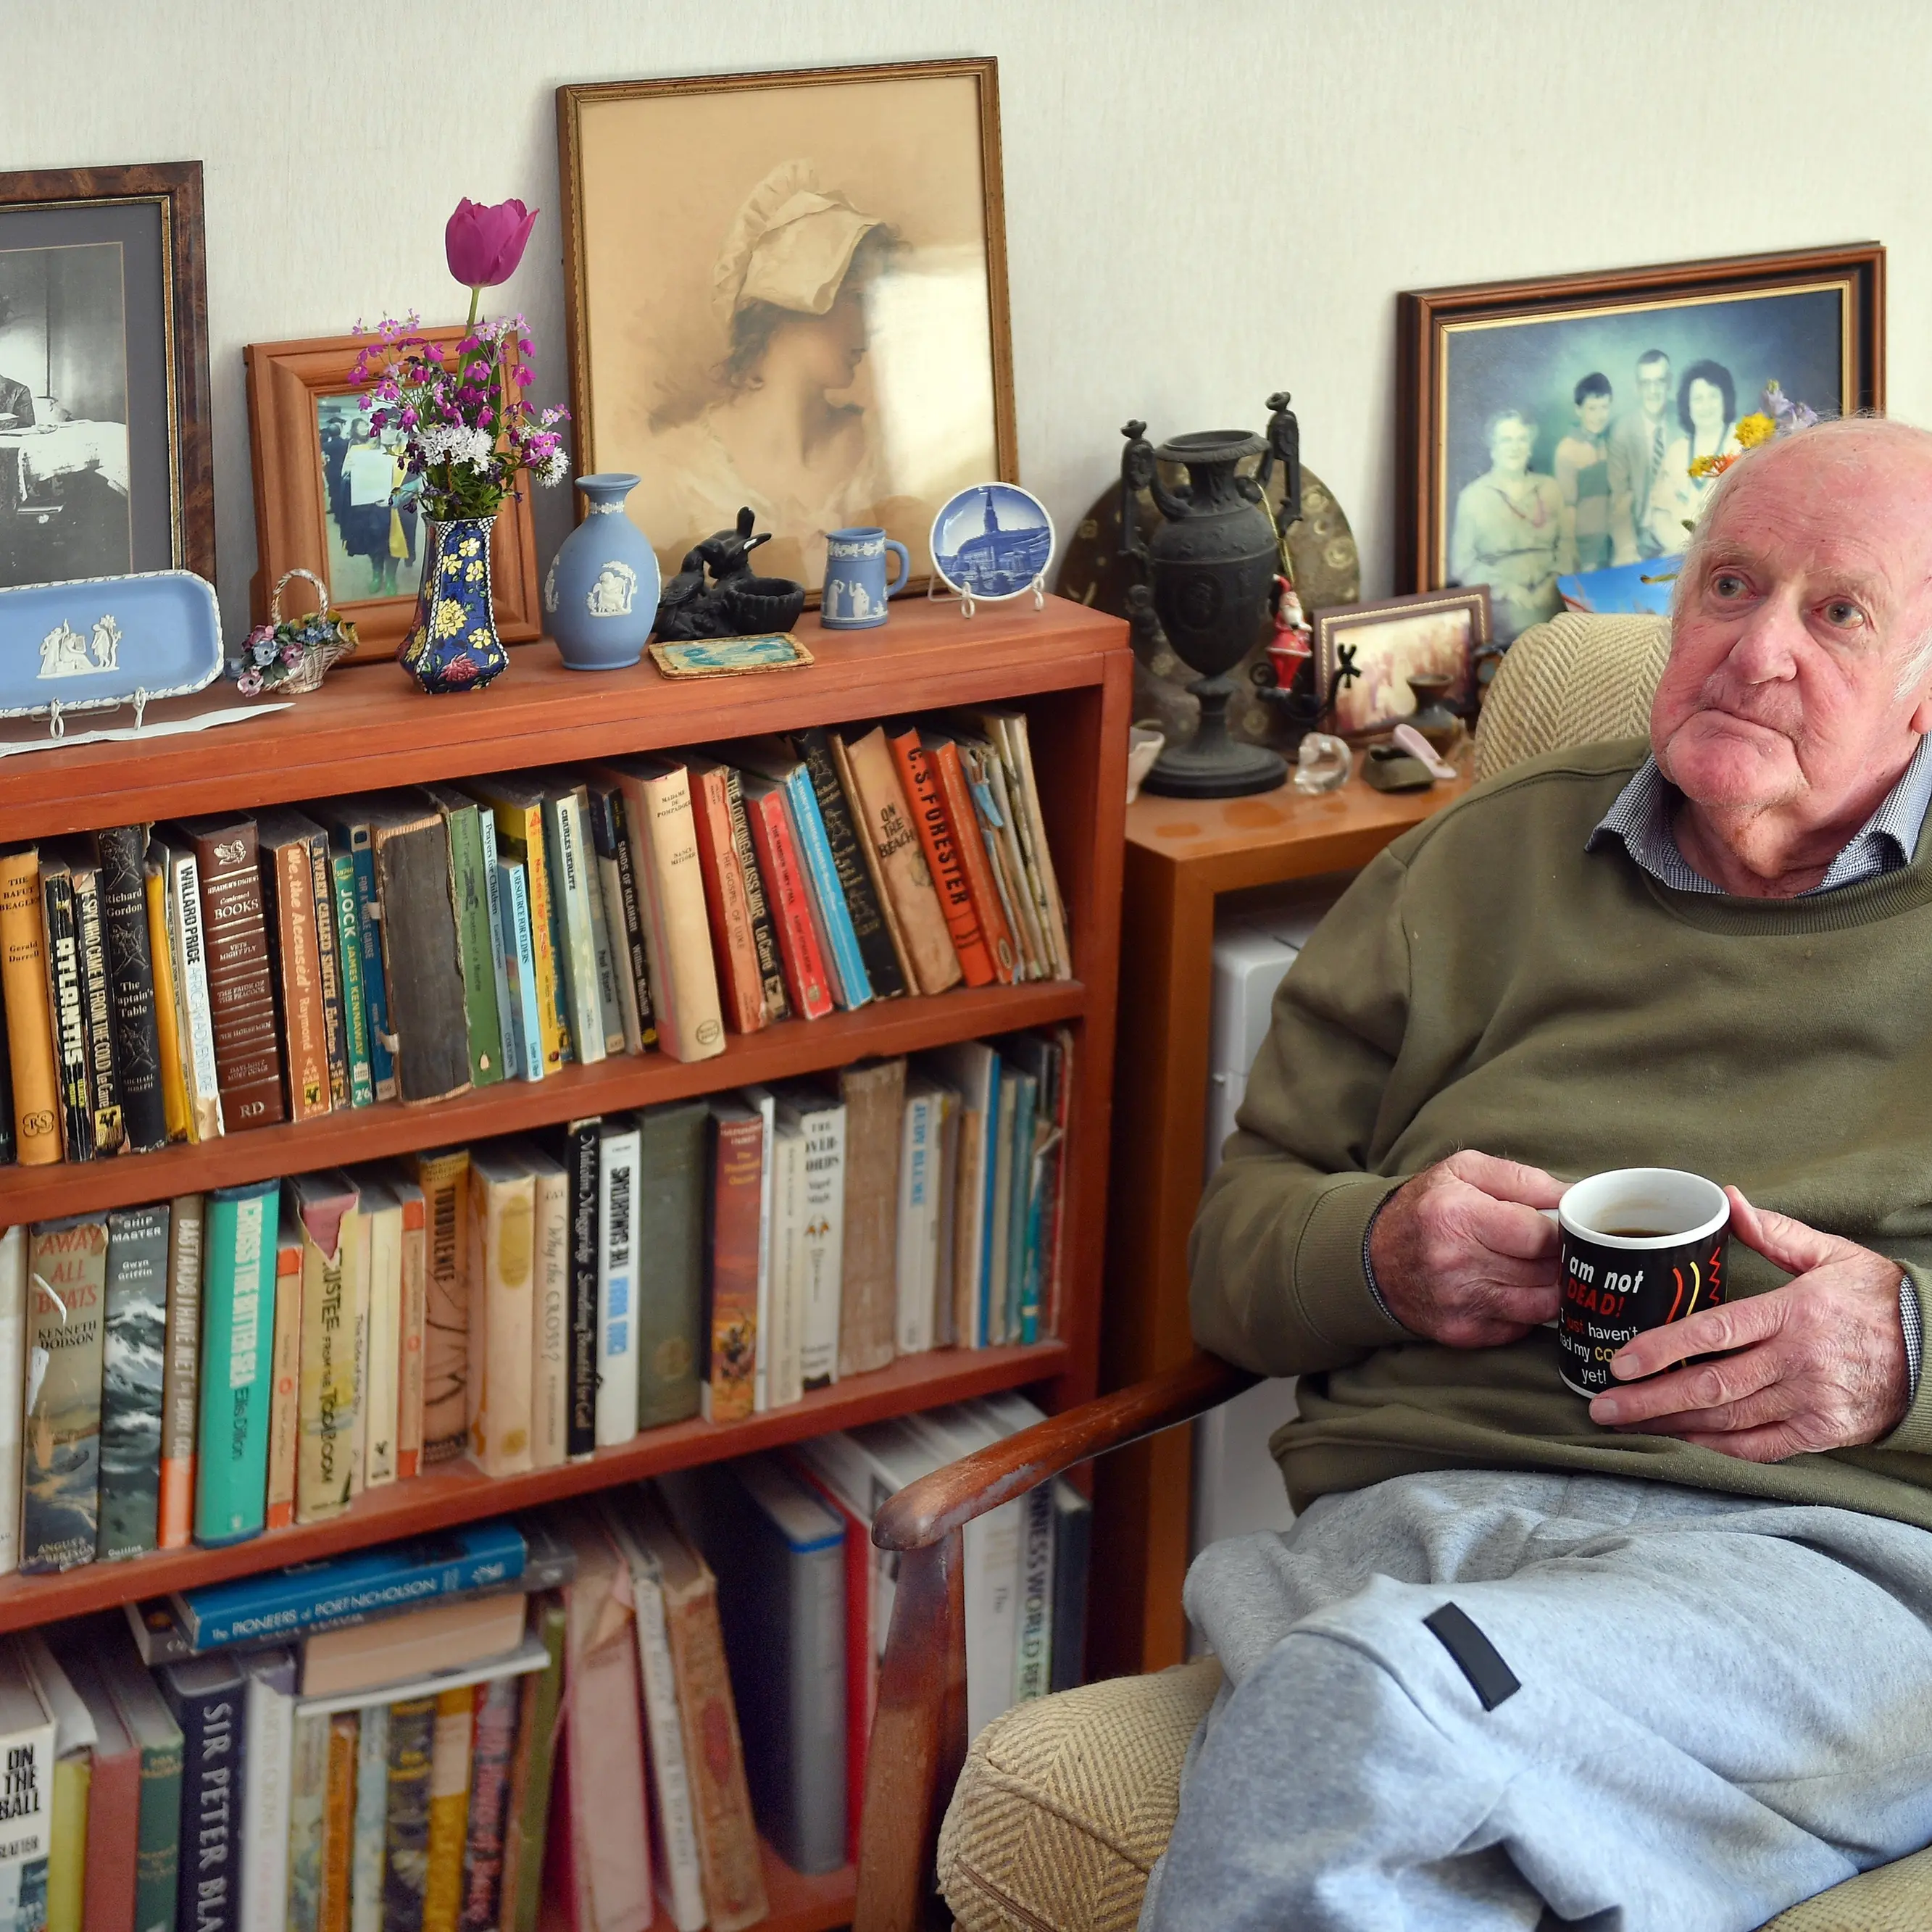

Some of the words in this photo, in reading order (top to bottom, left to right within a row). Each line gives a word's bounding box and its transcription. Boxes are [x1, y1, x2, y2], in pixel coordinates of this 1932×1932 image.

[662, 789, 685, 803] MADAME
[880, 802, 896, 822] ON
[484, 823, 496, 858] Prayers
[560, 809, 573, 851] CHARLES
[878, 828, 915, 857] BEACH
[880, 817, 904, 838] THE
[313, 846, 324, 857] A
[617, 841, 630, 871] SANDS
[673, 847, 692, 858] NANCY
[722, 851, 733, 869] THE
[725, 778, 741, 801] THE
[748, 891, 766, 919] WAR
[8, 875, 29, 886] THE
[315, 857, 328, 899] WREN
[488, 858, 498, 873] for
[565, 851, 577, 891] BERLITZ
[622, 873, 631, 885] OF
[3, 886, 36, 899] BAFUT
[106, 887, 143, 904] Richard
[180, 865, 198, 928] WILLARD
[489, 874, 500, 915] Children
[513, 877, 525, 917] RESOURCE
[725, 872, 738, 907] GOSPEL
[82, 899, 100, 920] SPY
[107, 902, 143, 917] Gordon
[214, 899, 259, 920] BOOKS
[340, 888, 357, 939] JOCK
[358, 875, 369, 892] FOR
[364, 933, 375, 959] CAUSE
[623, 887, 638, 933] KALAHARI
[732, 909, 742, 923] OF
[83, 919, 101, 946] WHO
[318, 902, 333, 952] CALLED
[518, 918, 527, 934] FOR
[734, 926, 746, 950] LUKE
[9, 941, 38, 953] Gerald
[9, 951, 40, 963] Durrell
[86, 946, 104, 977] CAME
[185, 927, 201, 966] PRICE
[292, 912, 311, 986] Accused
[520, 935, 530, 964] ELDERS
[598, 950, 610, 968] Paul
[631, 944, 645, 977] William
[320, 954, 337, 999] SMITH
[346, 944, 359, 983] JAMES
[88, 976, 105, 987] IN
[116, 988, 154, 1005] aptain's
[120, 980, 140, 992] The
[188, 967, 207, 1021] AFRICAN
[57, 936, 83, 1067] ATLANTIS
[90, 990, 107, 1020] FROM
[119, 1004, 147, 1019] Table
[92, 1022, 109, 1043] THE
[298, 996, 314, 1051] Raymond
[326, 1006, 339, 1054] Fullerton
[350, 986, 365, 1056] KENNAWAY
[94, 1042, 112, 1072] COLD
[193, 1022, 213, 1092] ADVENTURE
[504, 1032, 515, 1068] COLLINS
[240, 1101, 265, 1119] RD
[578, 1135, 595, 1191] Malcolm
[609, 1166, 630, 1246] SAMARITANS
[112, 1228, 162, 1244] MASTER
[123, 1216, 153, 1229] SHIP
[235, 1199, 263, 1264] CROSS
[433, 1184, 457, 1282] TURBULENCE
[540, 1215, 565, 1259] Why
[574, 1191, 594, 1262] Muggeridge
[38, 1225, 102, 1256] AWAY
[51, 1259, 86, 1283] ALL
[122, 1259, 149, 1271] Gwyn
[176, 1219, 200, 1296] BASTARDS
[609, 1248, 629, 1271] THE
[1560, 1243, 1566, 1264] I
[1569, 1255, 1594, 1283] am
[1604, 1270, 1644, 1294] not
[118, 1268, 153, 1281] Griffin
[546, 1262, 563, 1286] the
[36, 1286, 99, 1314] BOATS
[1566, 1279, 1625, 1319] DEAD!
[38, 1321, 97, 1340] KENNETH
[175, 1307, 196, 1344] HAVE
[541, 1291, 562, 1362] CROSS?
[1588, 1322, 1639, 1342] haven't
[40, 1333, 94, 1350] DODSON
[322, 1336, 333, 1363] FROM
[1574, 1344, 1591, 1362] my
[175, 1346, 195, 1378] MET
[229, 1352, 257, 1389] SEA
[1581, 1367, 1607, 1385] yet!
[575, 1403, 592, 1429] God
[231, 1418, 248, 1462] Dillon
[232, 1609, 297, 1636] PIONEERS
[349, 1578, 438, 1606] NICHOLSON
[1023, 1571, 1045, 1659] WORLD
[202, 1701, 233, 1762] SIR
[8, 1742, 35, 1770] ON
[4, 1765, 36, 1795] THE
[0, 1791, 40, 1821] BALL
[199, 1766, 232, 1873] PETER
[196, 1875, 228, 1932] BLA
